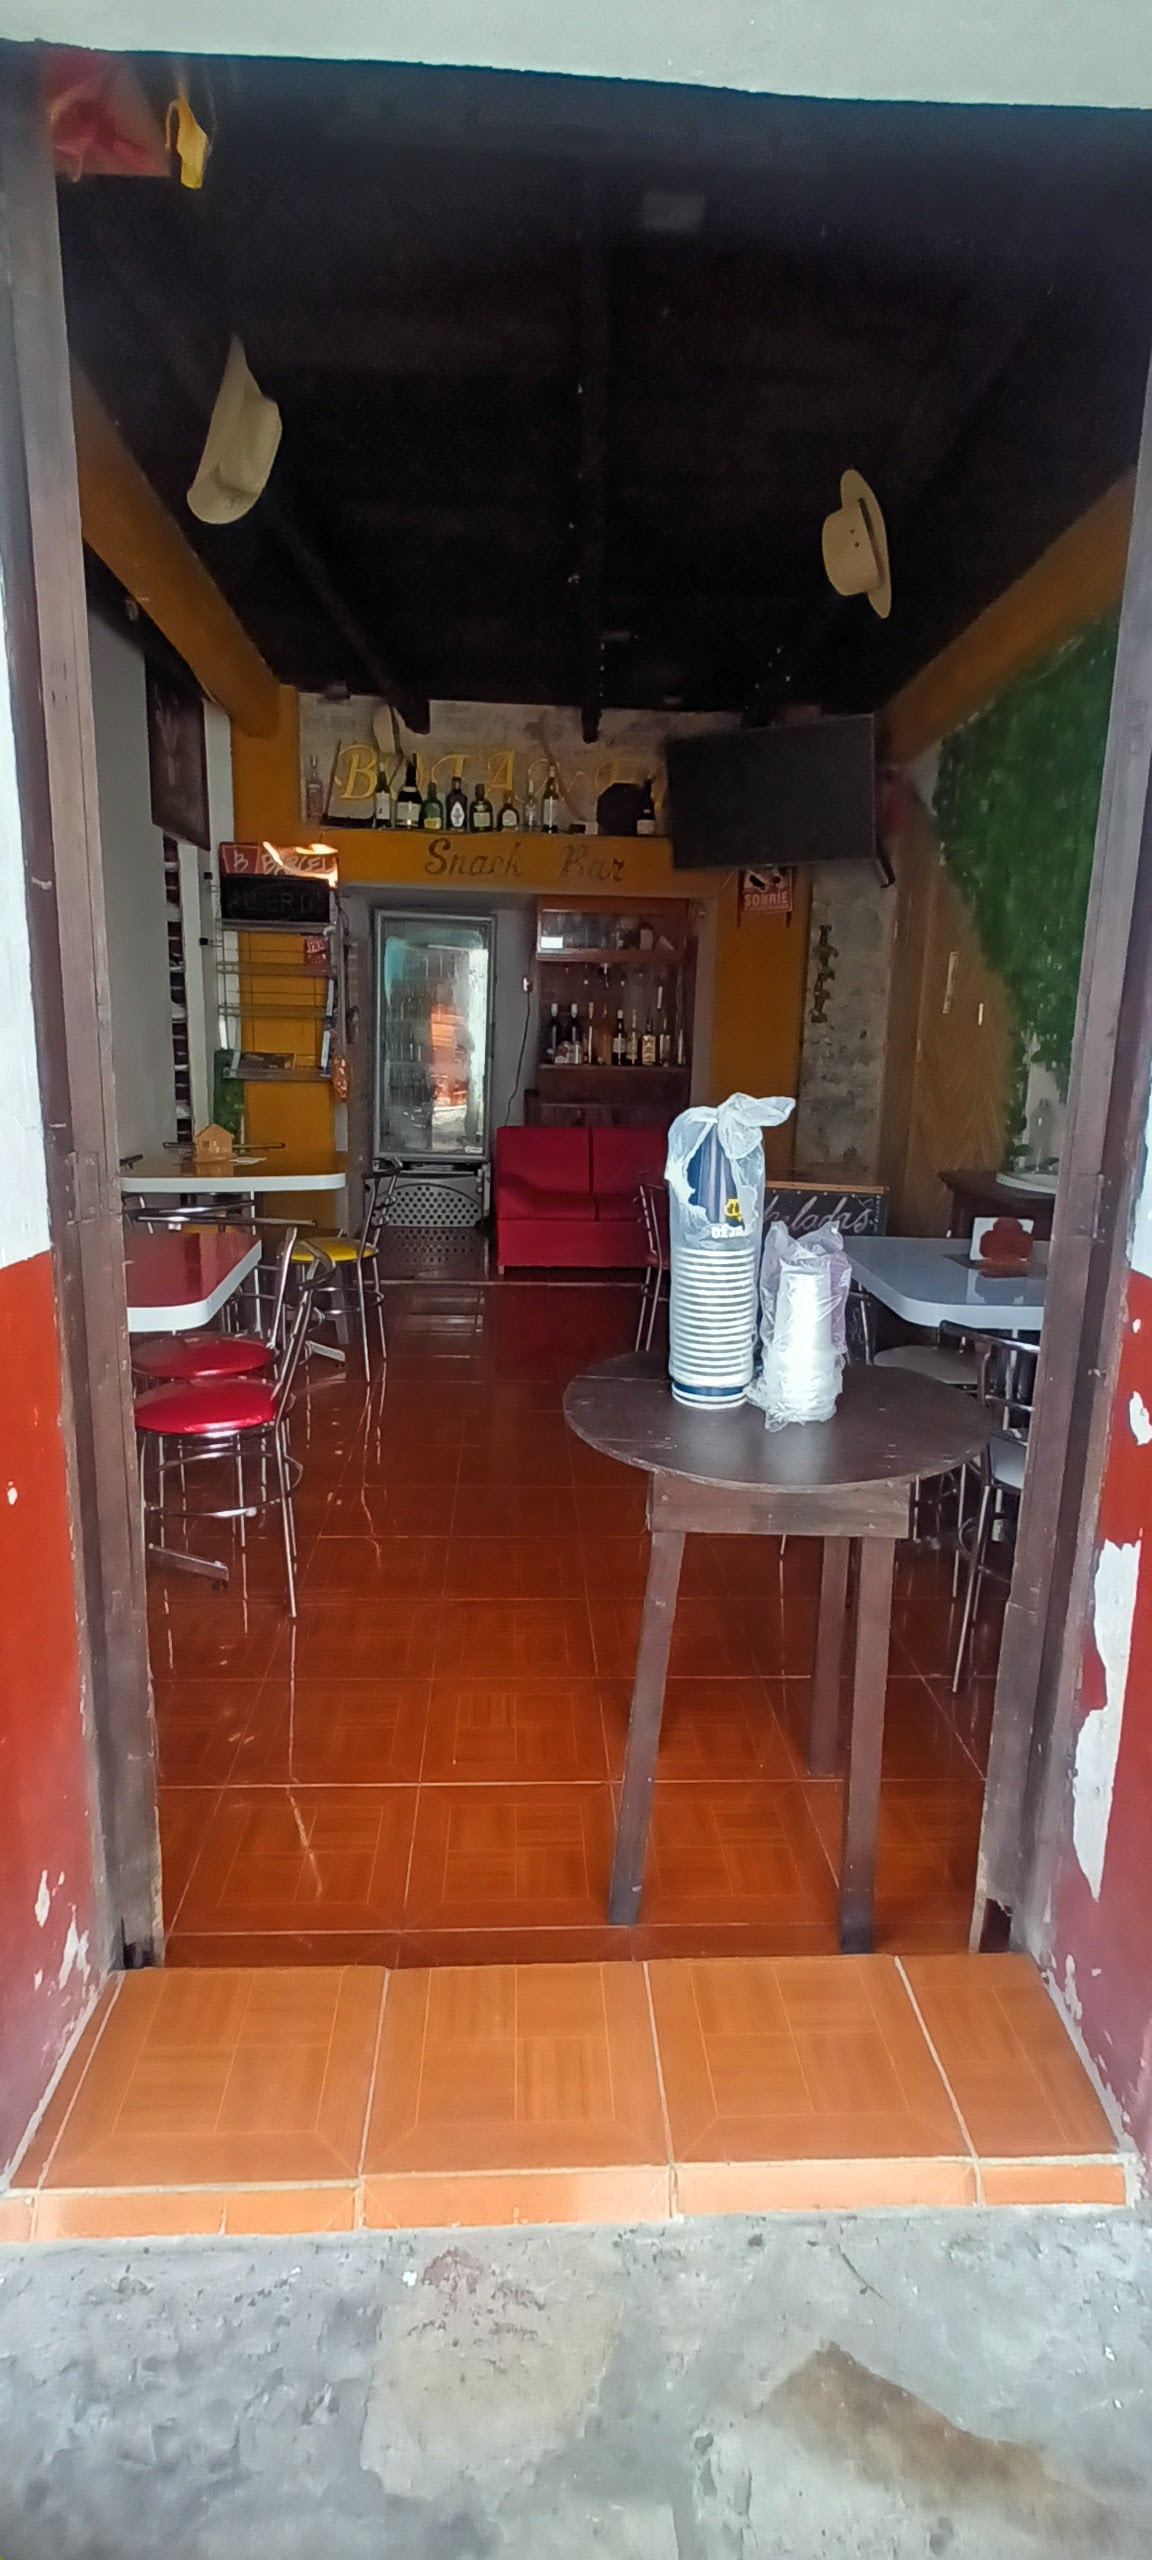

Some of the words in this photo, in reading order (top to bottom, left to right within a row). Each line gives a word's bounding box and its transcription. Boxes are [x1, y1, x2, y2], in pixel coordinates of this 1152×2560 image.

[424, 837, 525, 877] Snack
[560, 843, 626, 882] Bar
[764, 1195, 873, 1234] heladas
